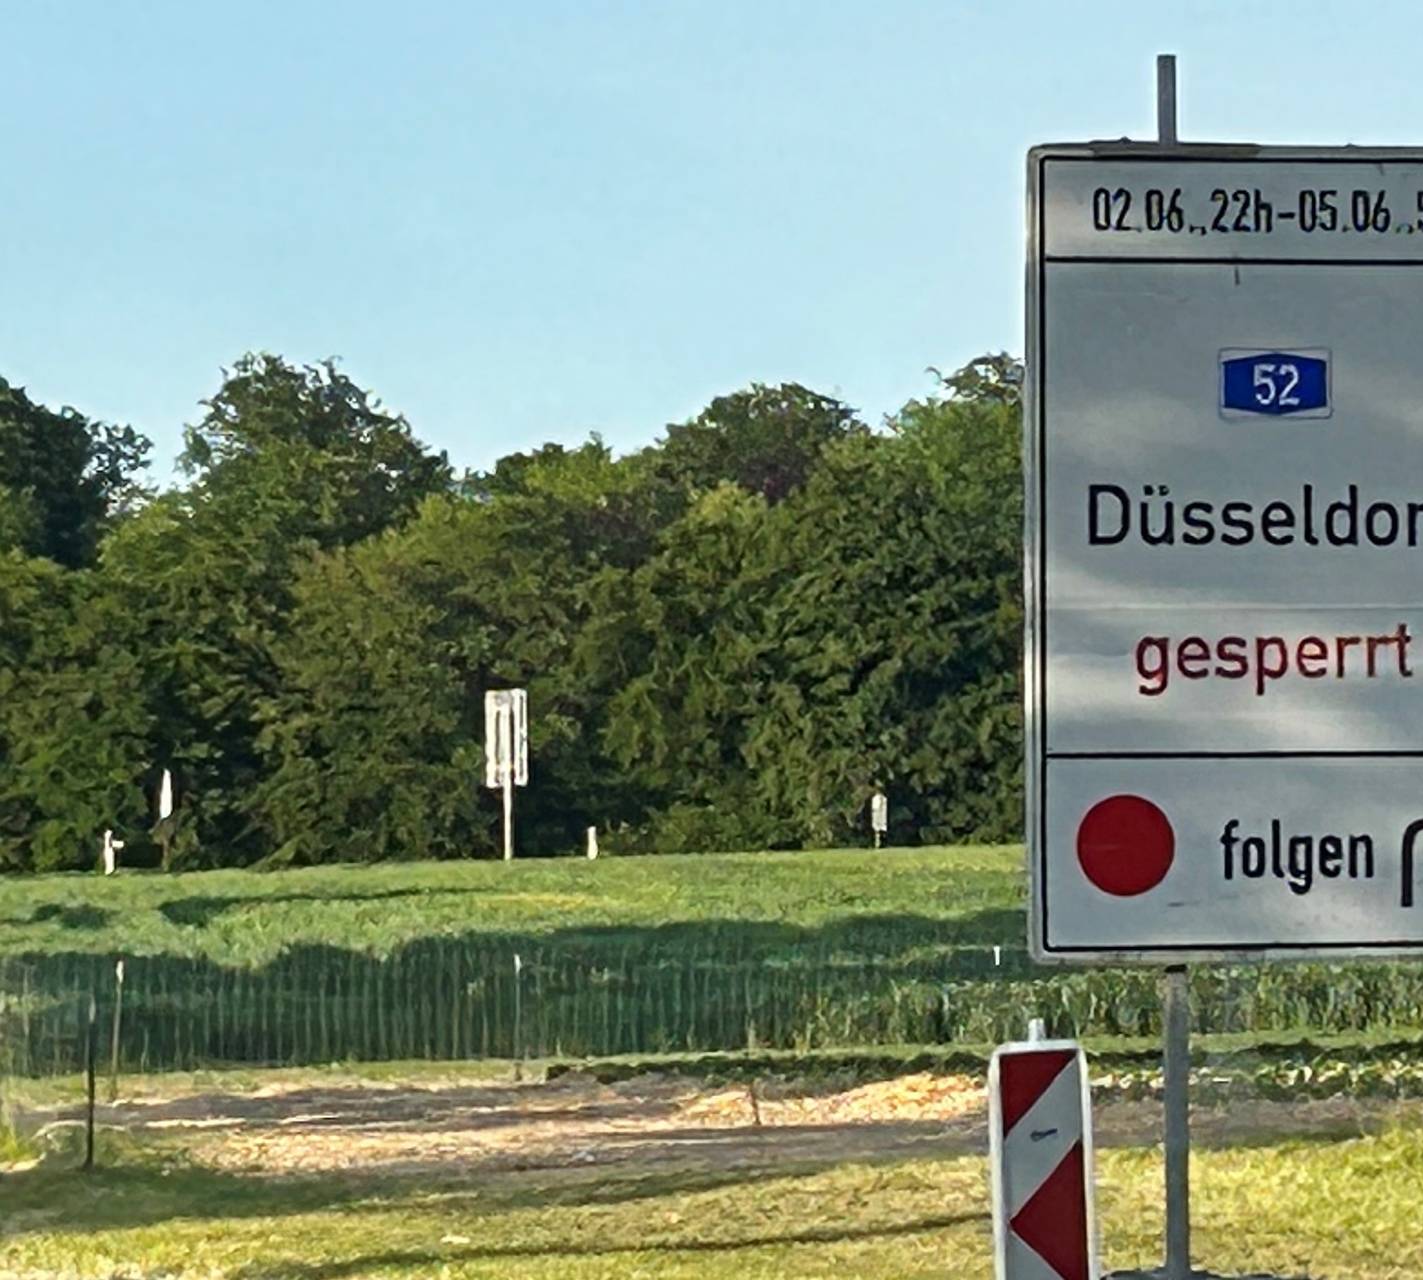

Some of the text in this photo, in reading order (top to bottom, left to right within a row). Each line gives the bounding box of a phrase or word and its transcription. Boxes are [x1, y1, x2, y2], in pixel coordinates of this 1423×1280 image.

[1254, 364, 1299, 405] 52
[1136, 622, 1413, 696] gesperrt
[1220, 819, 1374, 895] folgen
